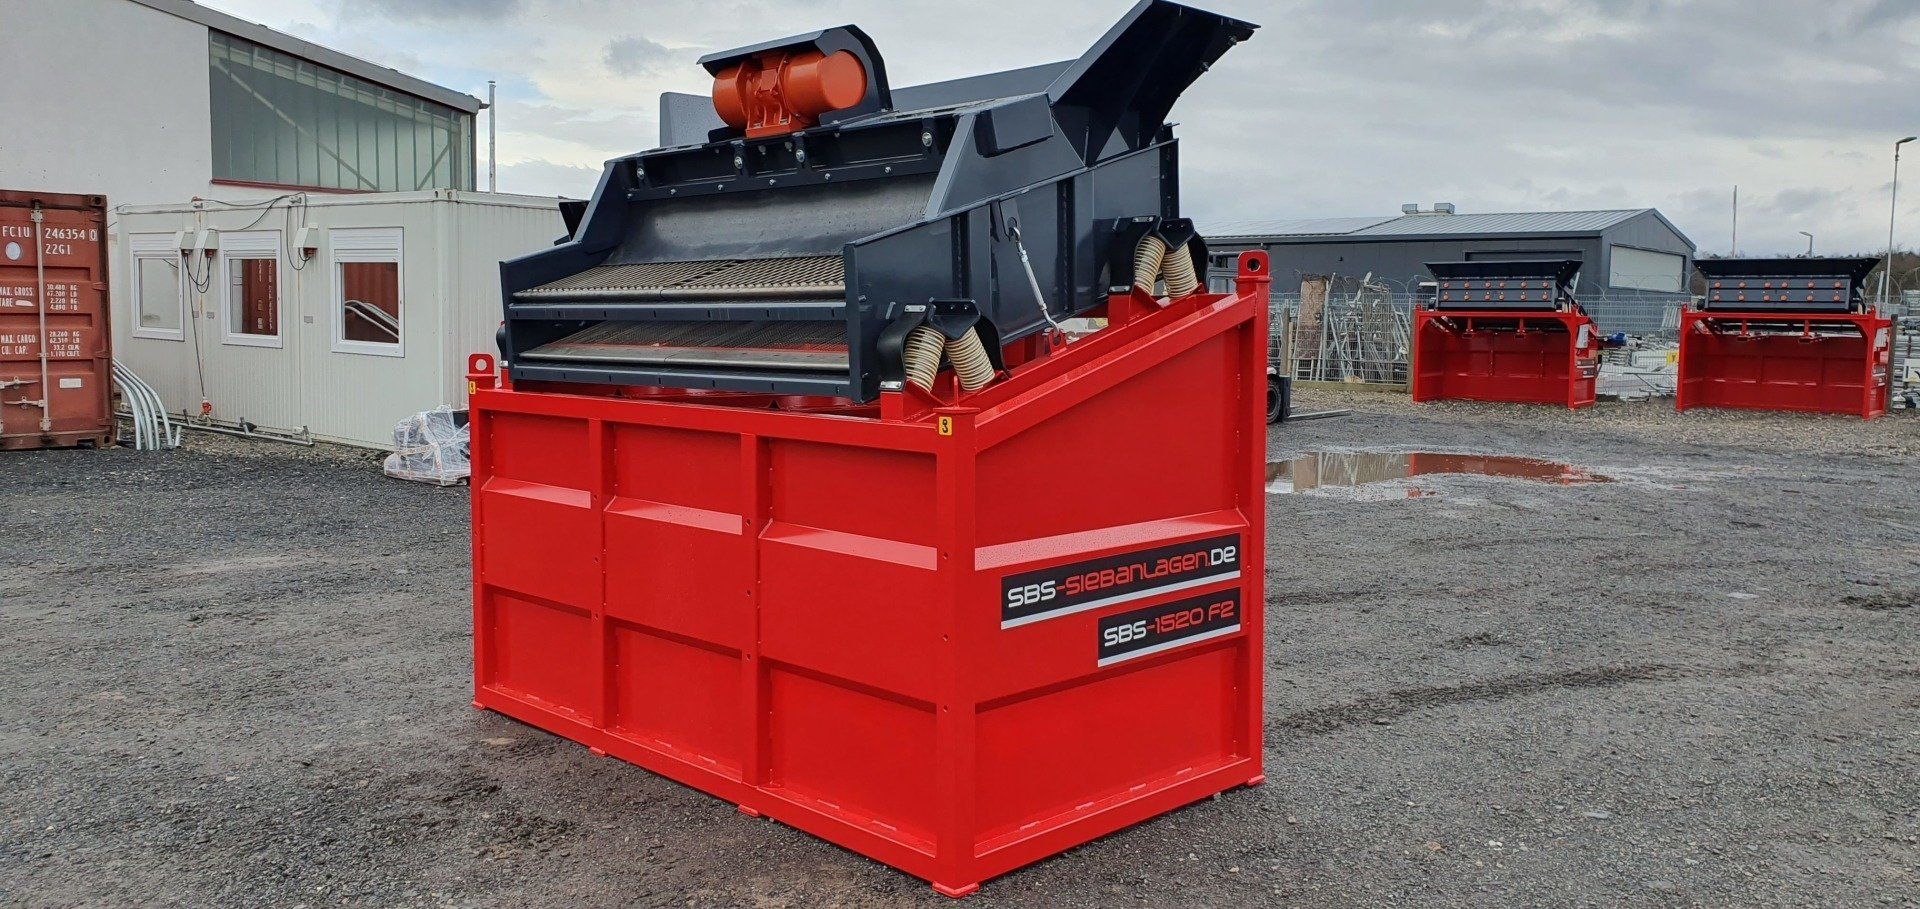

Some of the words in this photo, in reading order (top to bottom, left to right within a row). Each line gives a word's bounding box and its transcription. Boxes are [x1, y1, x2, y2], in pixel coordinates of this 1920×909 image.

[2, 225, 30, 238] FCIU
[45, 227, 86, 240] 246354
[1103, 609, 1204, 647] SBS-1520
[1208, 600, 1235, 622] F2
